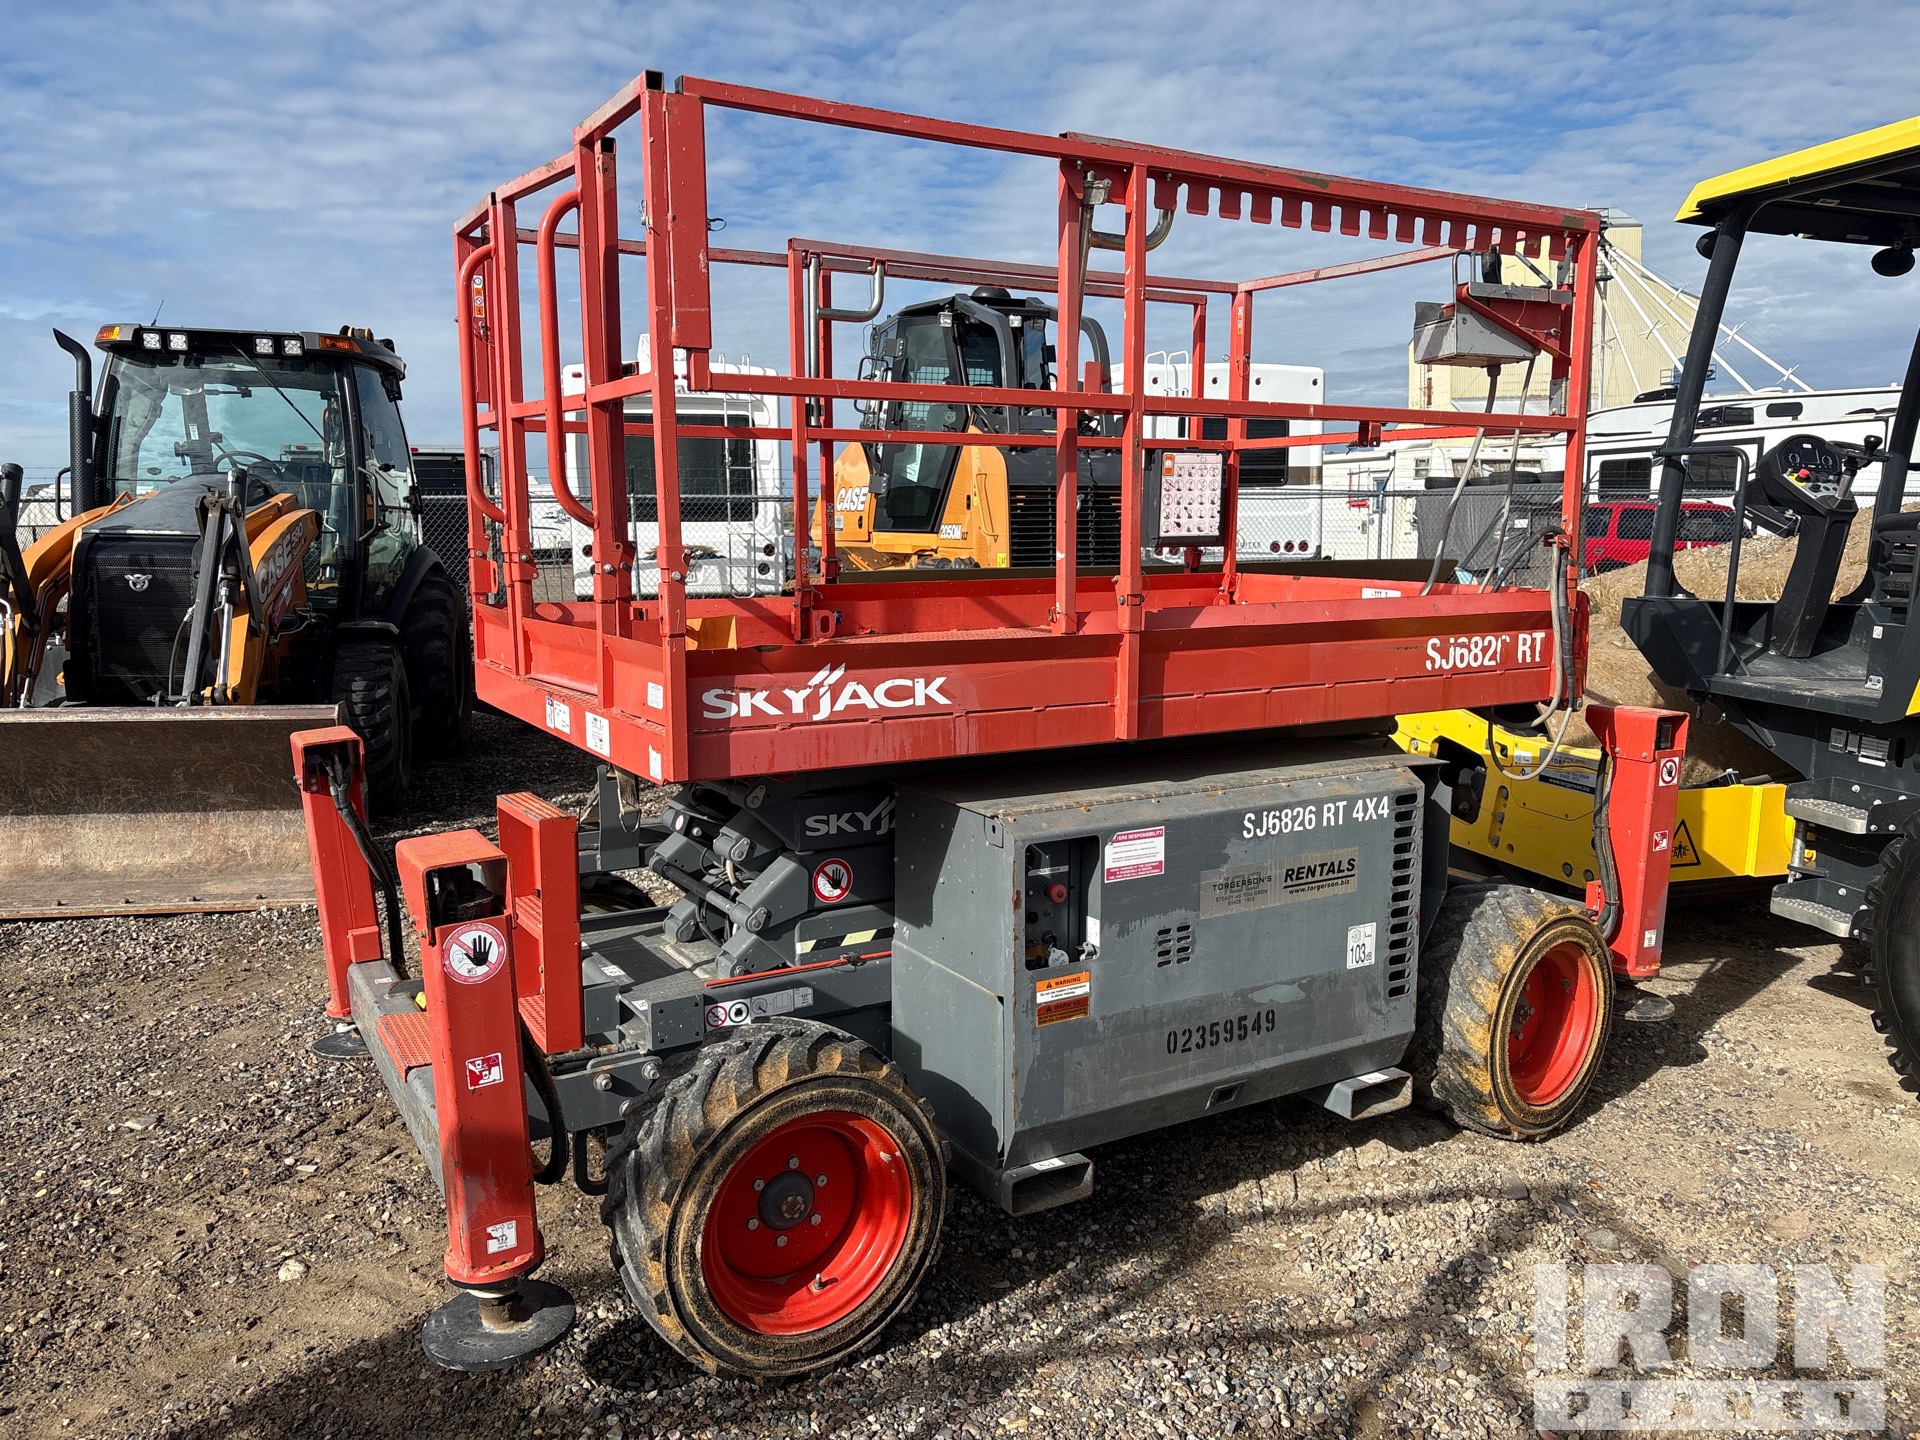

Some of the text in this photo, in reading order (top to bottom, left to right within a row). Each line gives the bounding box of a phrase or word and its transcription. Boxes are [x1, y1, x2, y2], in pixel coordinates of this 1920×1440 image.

[836, 486, 869, 511] CASE
[940, 523, 961, 540] 2050M
[258, 533, 292, 603] CASE
[1517, 632, 1546, 663] RT
[701, 663, 953, 721] SKYJACK
[805, 796, 896, 836] SKYJ
[1242, 796, 1389, 839] SJ6826 RT 4X4
[1128, 830, 1163, 839] RESPONSIBILITY
[1284, 858, 1356, 883] RENTALS
[1212, 875, 1272, 891] TORGERSON'S
[1289, 879, 1350, 895] www.torgerson.biz
[1216, 895, 1234, 903] STEADY
[1350, 943, 1366, 965] 103
[1055, 976, 1081, 986] WARNING
[1055, 1000, 1081, 1010] WARNING
[1166, 1008, 1276, 1055] 02359549
